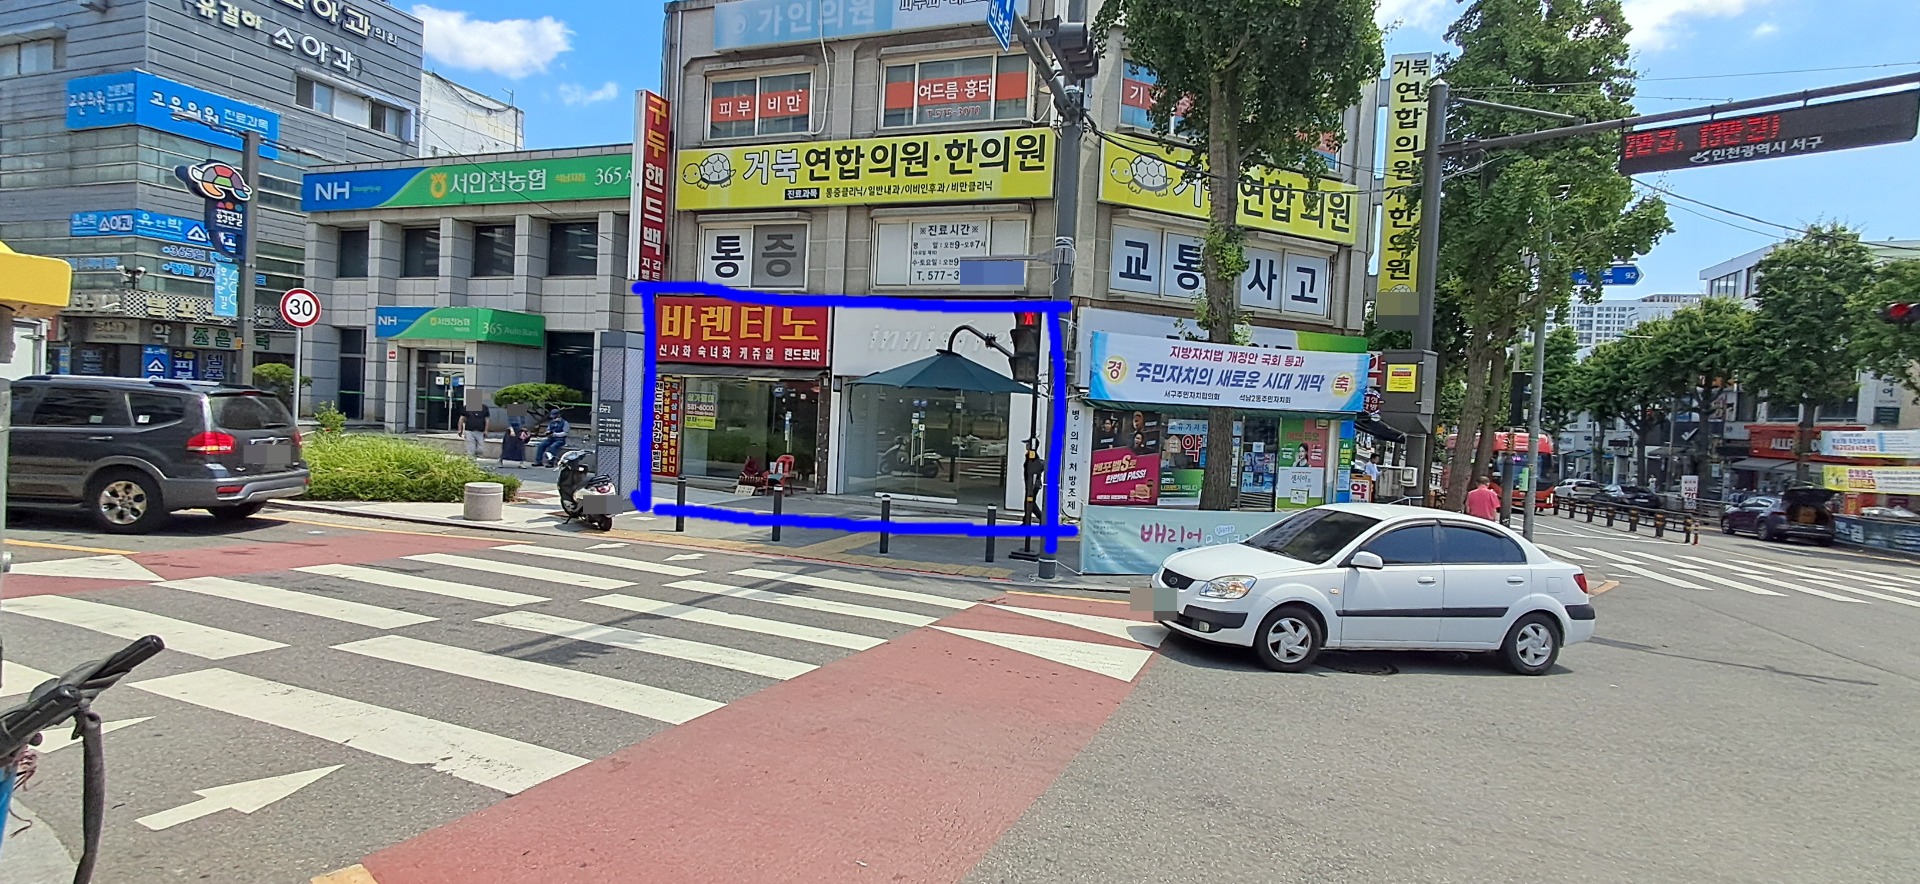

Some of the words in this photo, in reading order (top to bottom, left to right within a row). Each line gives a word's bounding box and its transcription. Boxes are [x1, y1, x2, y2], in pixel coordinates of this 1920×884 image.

[1393, 58, 1430, 77] 거북
[718, 100, 752, 117] 피부
[767, 92, 802, 113] 비만
[647, 95, 667, 158] 구두
[1711, 141, 1786, 161] 인천광역시
[1789, 135, 1824, 151] 서구
[315, 181, 350, 201] NH
[450, 168, 547, 194] 서인천농협
[594, 167, 623, 186] 365
[643, 163, 664, 256] 핸드백
[1624, 272, 1636, 280] 92
[289, 300, 313, 317] 30
[377, 316, 398, 326] NH
[482, 322, 503, 336] 365
[661, 304, 819, 342] 바렌티노
[192, 327, 271, 350] 조은국
[659, 344, 692, 358] 신사화
[698, 345, 731, 359] 숙녀화
[1169, 345, 1224, 363] 지방자치법
[1227, 351, 1259, 366] 개정안
[1261, 353, 1282, 367] 국회
[1284, 355, 1305, 368] 통과
[1107, 360, 1122, 380] 경
[1136, 361, 1213, 386] 주민자치의
[1215, 369, 1260, 389] 새로운
[1262, 372, 1292, 390] 시대
[1294, 373, 1325, 392] 개막
[1334, 375, 1350, 392] 축
[1181, 434, 1204, 463] 약
[1350, 483, 1367, 499] 약
